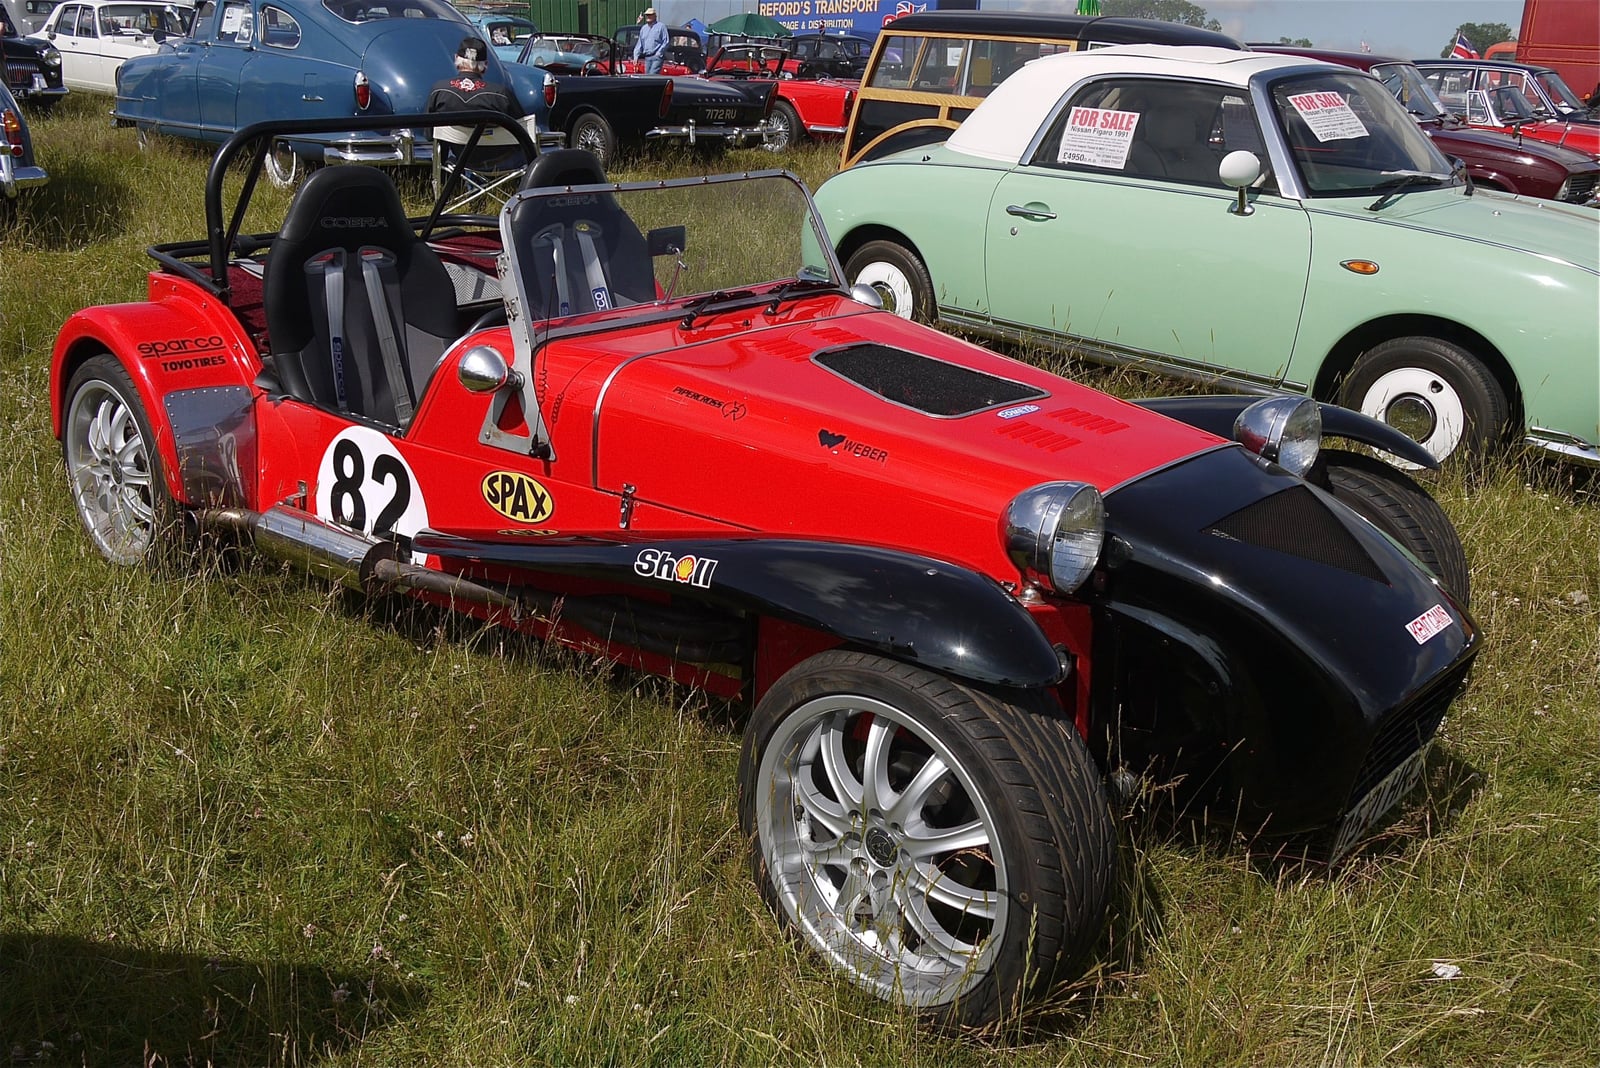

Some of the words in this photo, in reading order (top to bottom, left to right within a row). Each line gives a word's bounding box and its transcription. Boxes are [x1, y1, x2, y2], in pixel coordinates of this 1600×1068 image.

[815, 0, 879, 14] TRANSPORT
[1292, 96, 1319, 111] FOR
[1315, 93, 1344, 107] SALE
[705, 109, 724, 119] 7172
[725, 109, 737, 119] RU
[1072, 109, 1099, 127] FOR
[1101, 112, 1135, 130] SALE
[1093, 128, 1112, 136] Figaro
[321, 216, 388, 229] COBRA
[137, 336, 224, 358] sparco
[672, 386, 723, 409] PIPERCROSS
[843, 439, 888, 463] WEBER
[330, 438, 411, 536] 82
[487, 474, 547, 519] SPAX
